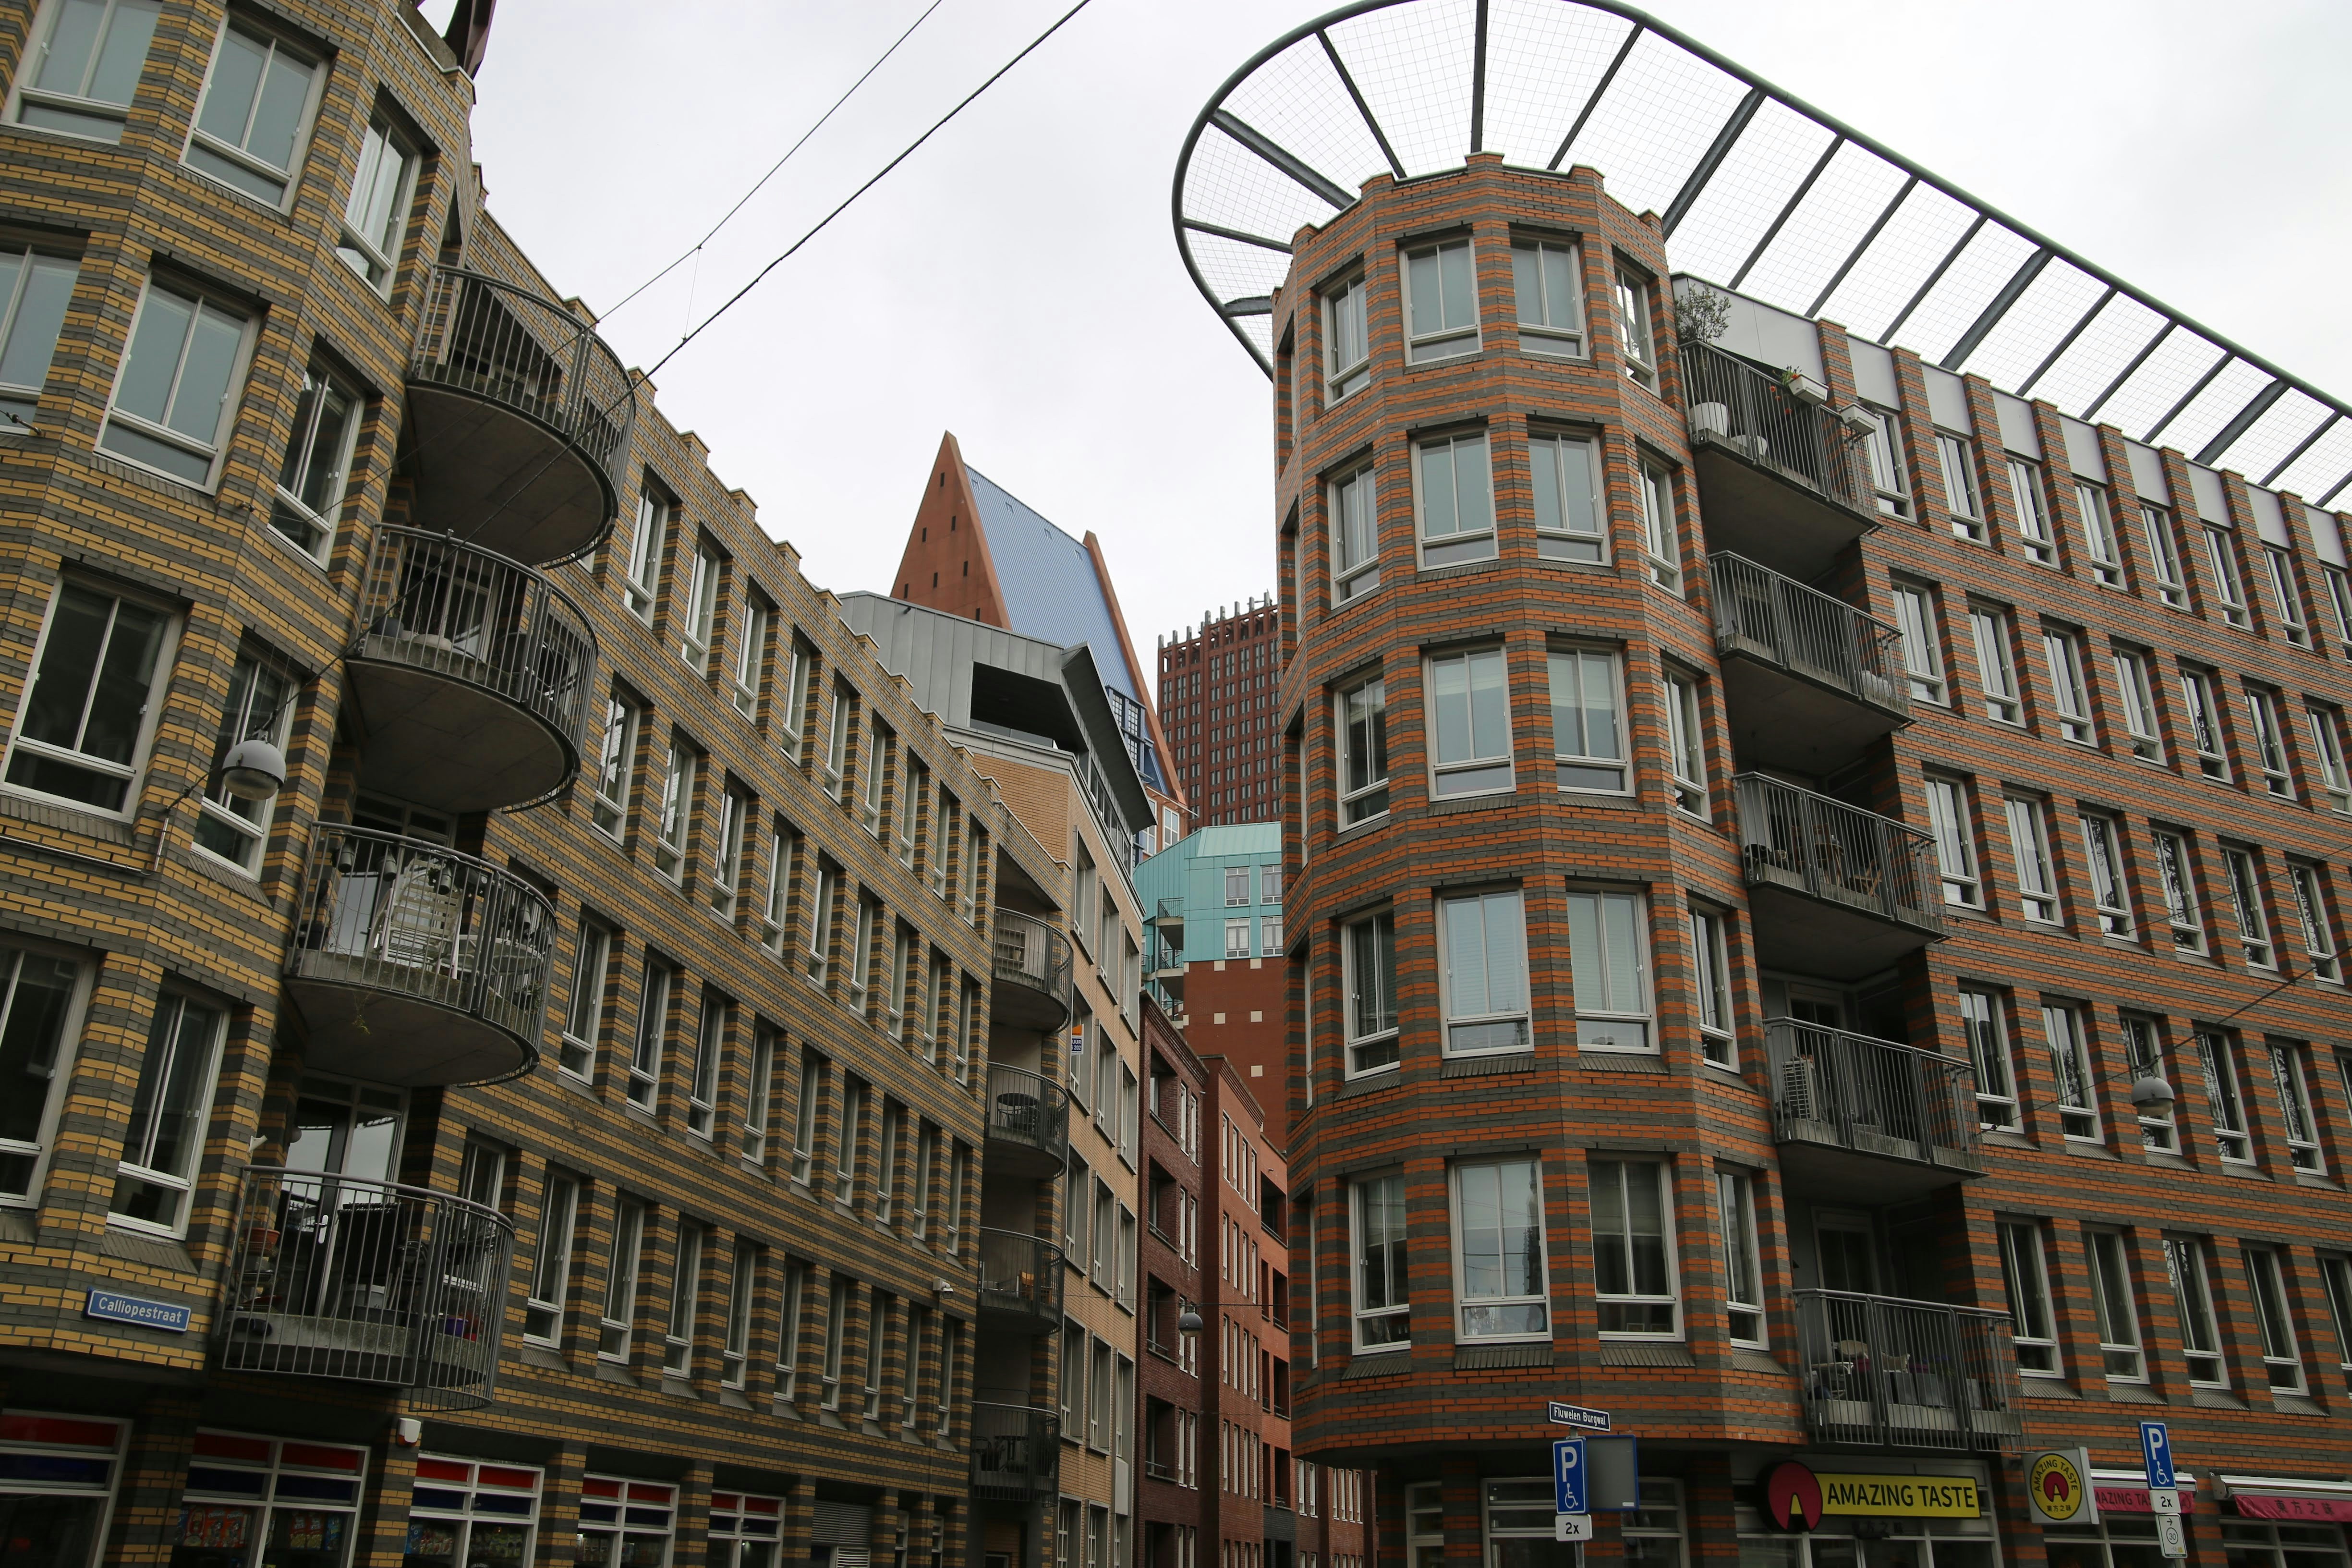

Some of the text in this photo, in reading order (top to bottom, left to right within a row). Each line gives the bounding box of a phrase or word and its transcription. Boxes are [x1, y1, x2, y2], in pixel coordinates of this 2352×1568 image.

[99, 1297, 182, 1323] Calliopestraat
[1553, 1407, 1606, 1427] Fluwelen Burgwal
[2148, 1428, 2163, 1460] P
[1561, 1446, 1577, 1482] P
[2034, 1459, 2078, 1492] AMAZING TASTE
[1827, 1483, 1975, 1508] AMAZING TASTE
[2096, 1492, 2133, 1505] MAZING
[2160, 1496, 2172, 1507] 2x
[1565, 1522, 1580, 1534] 2x
